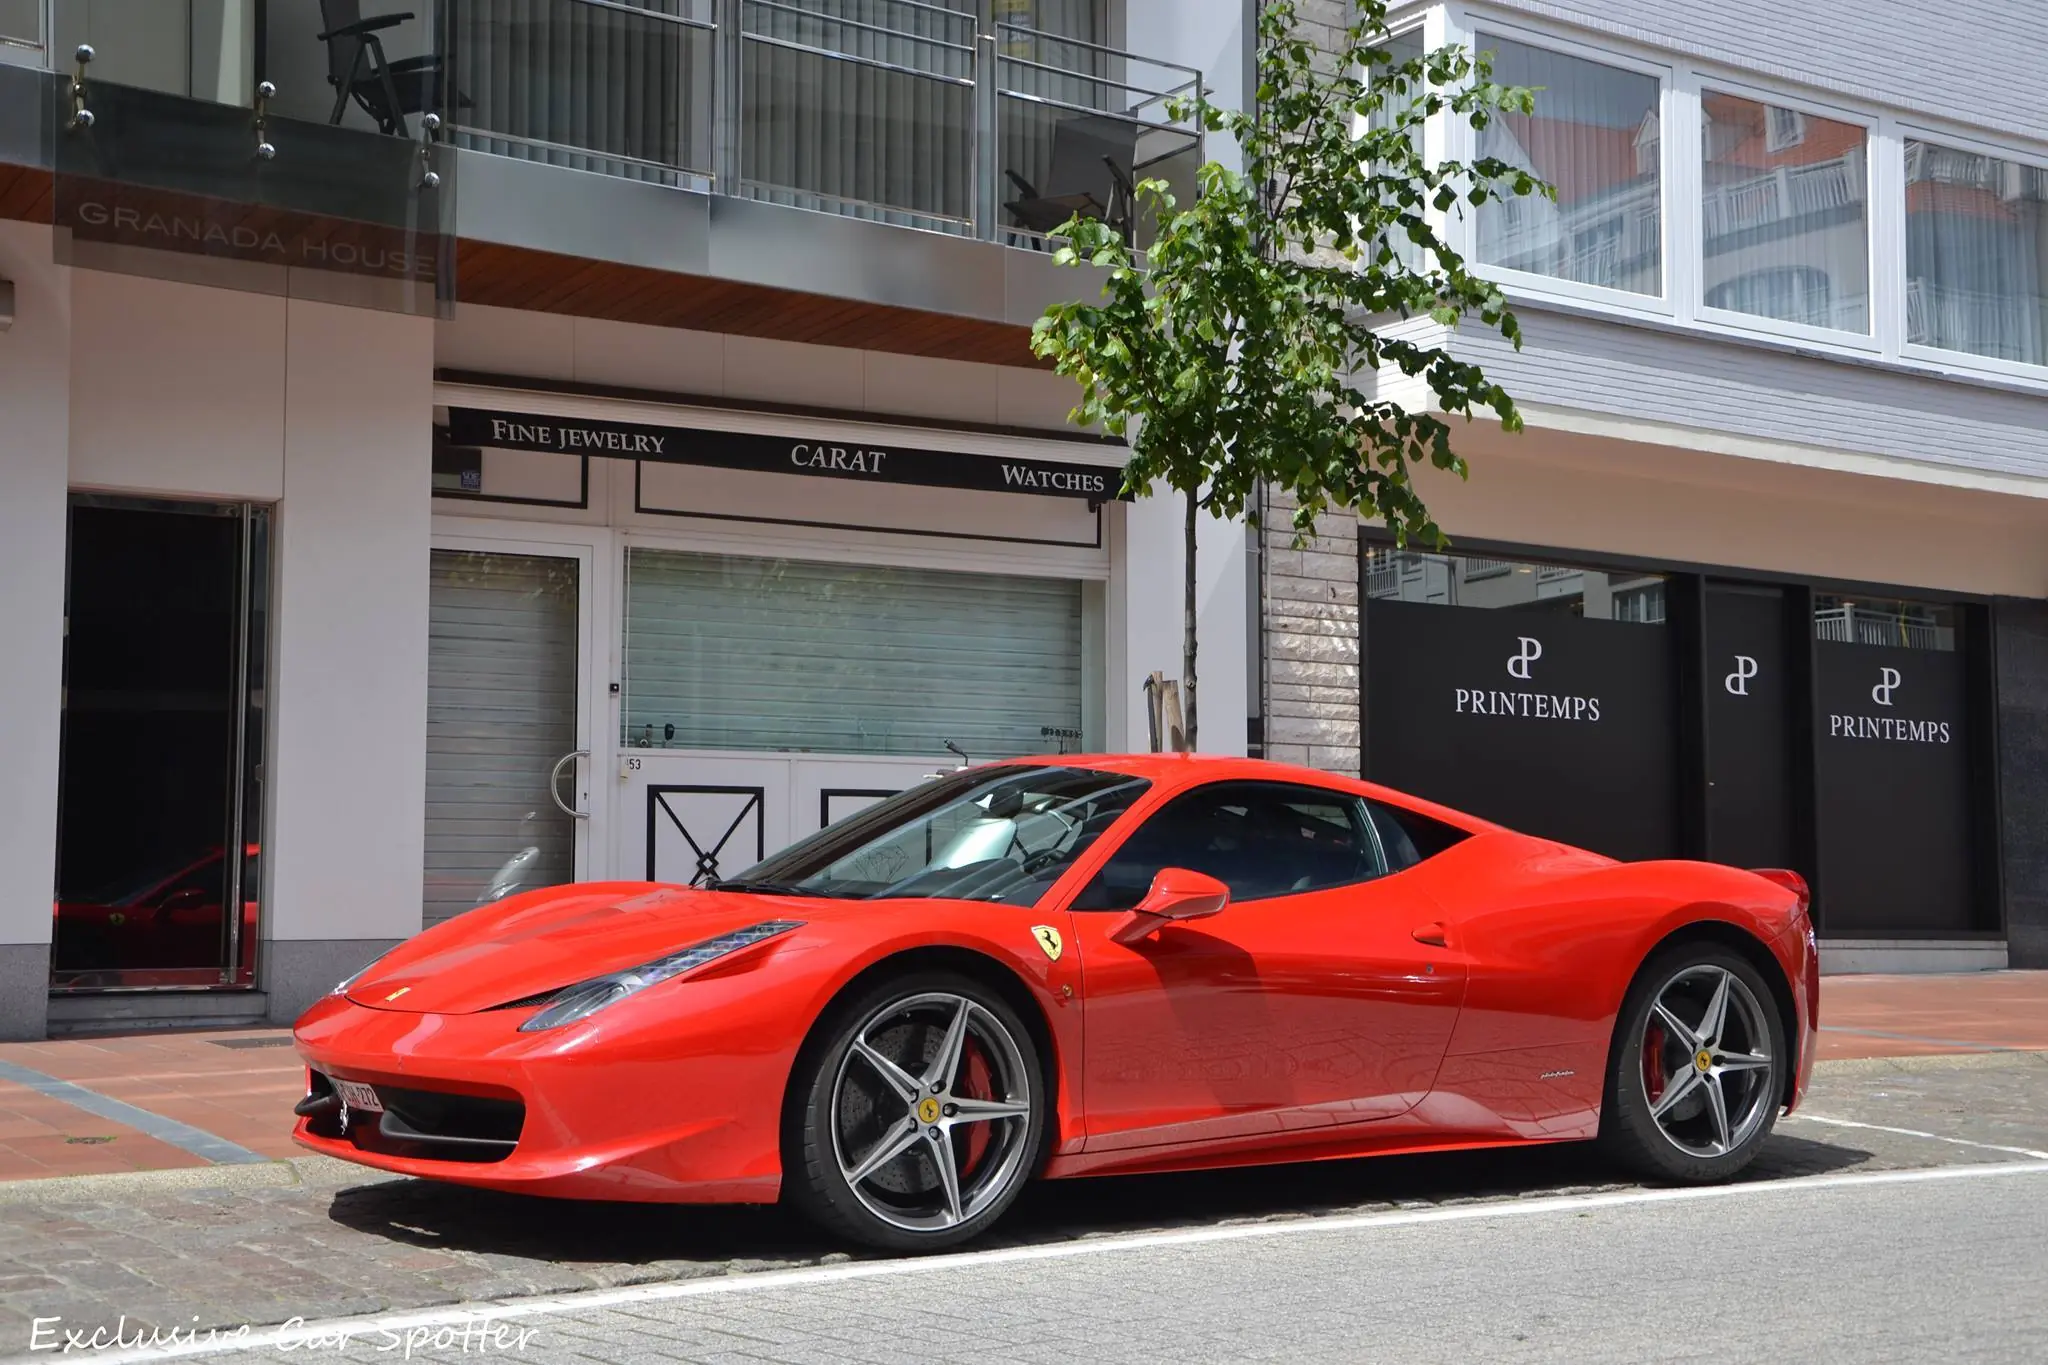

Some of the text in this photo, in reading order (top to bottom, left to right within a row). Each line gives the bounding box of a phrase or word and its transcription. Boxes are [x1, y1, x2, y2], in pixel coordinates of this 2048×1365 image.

[78, 201, 436, 276] GRANADA HOUSE
[558, 427, 666, 454] JEWELRY
[790, 444, 887, 474] CARAT
[1001, 463, 1105, 493] WATCHES
[1455, 688, 1600, 722] PRINTEMPS
[1830, 714, 1950, 744] PRINTEMPS
